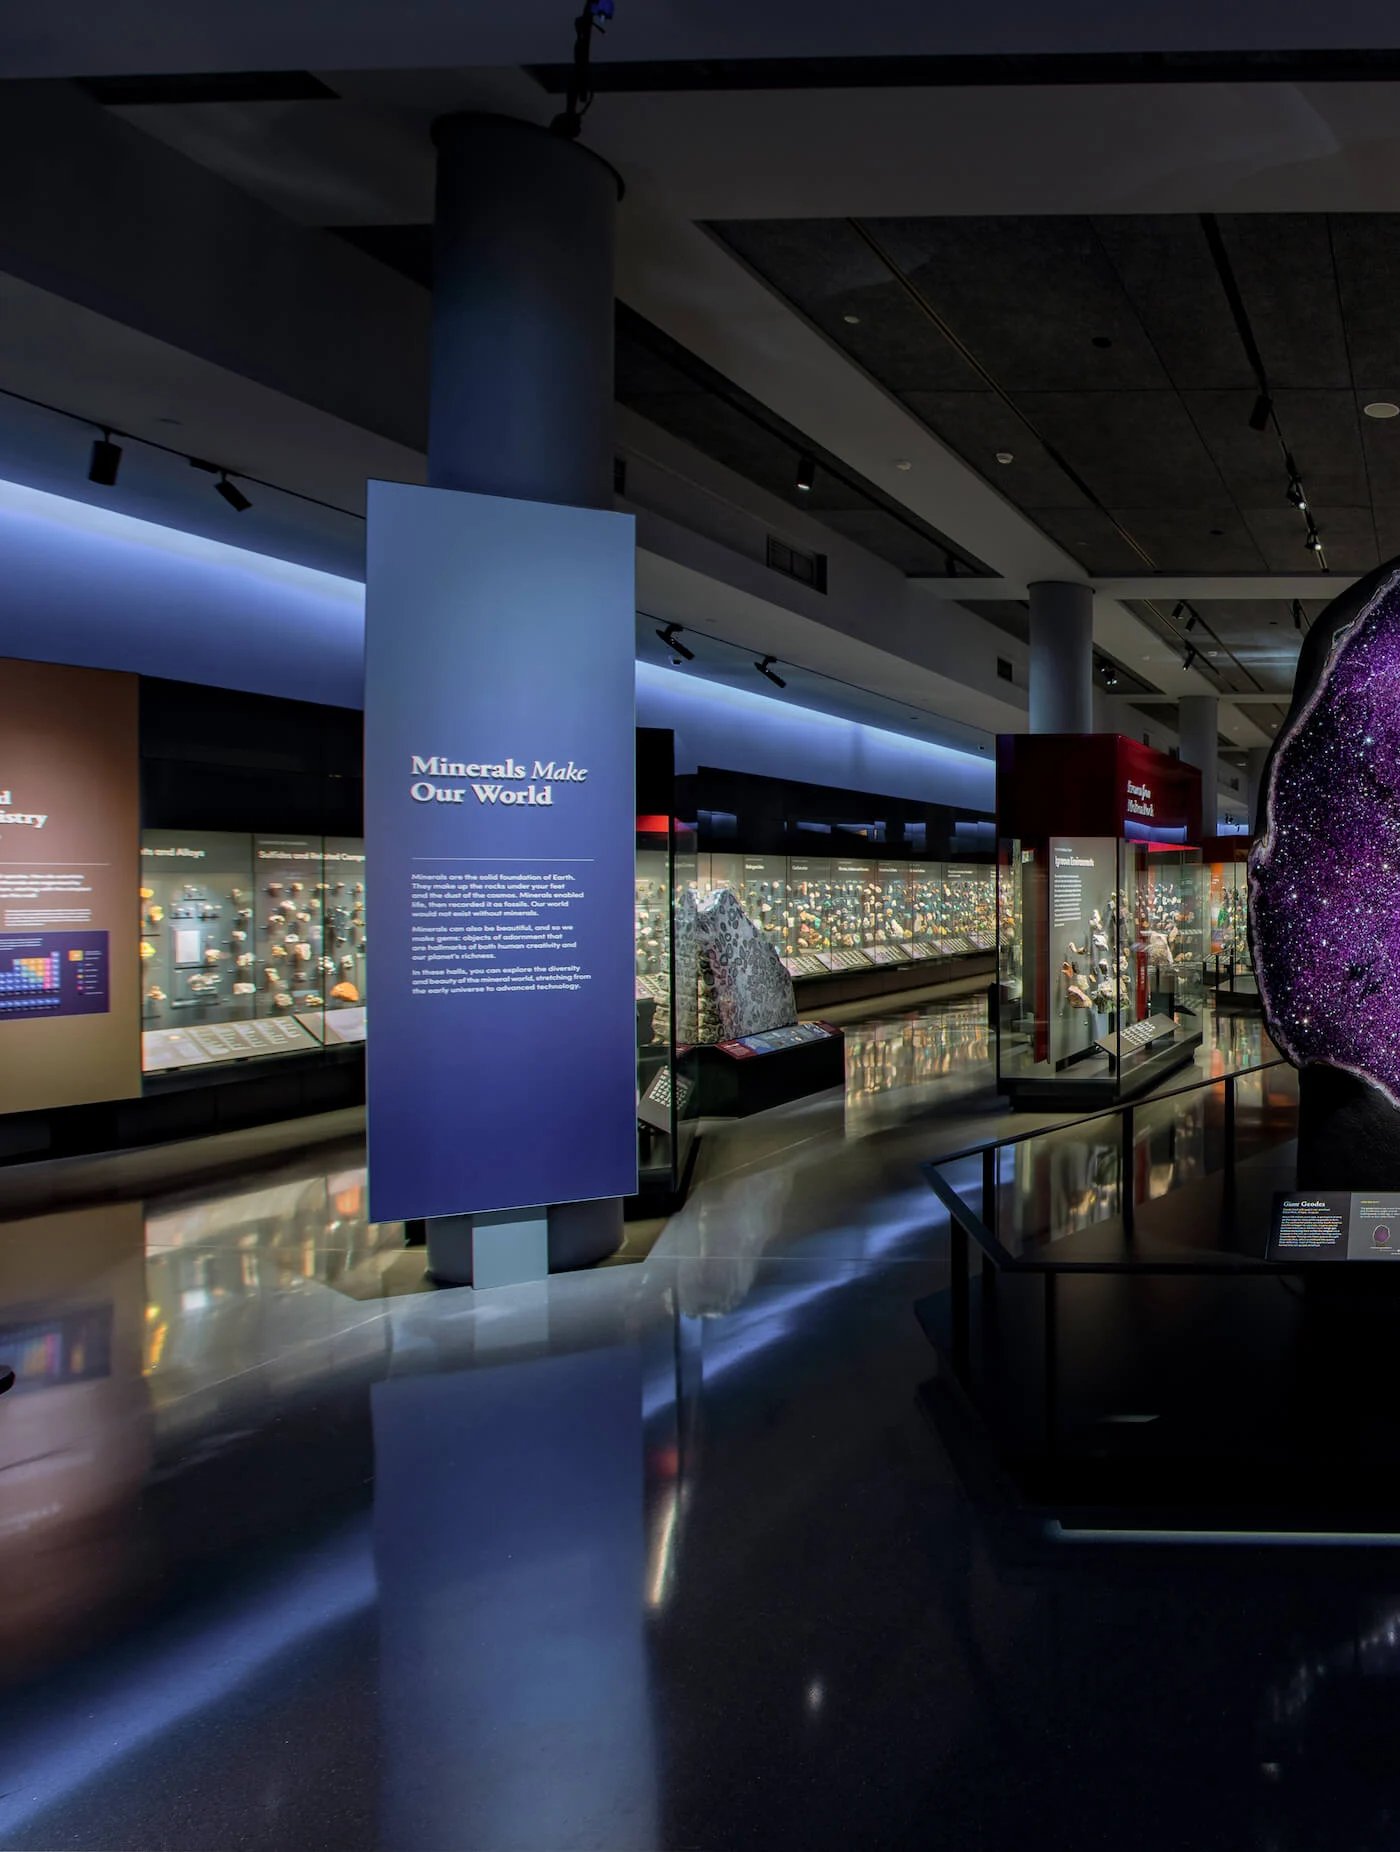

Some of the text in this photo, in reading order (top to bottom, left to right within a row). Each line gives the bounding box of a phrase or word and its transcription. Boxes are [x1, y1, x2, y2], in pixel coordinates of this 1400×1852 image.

[410, 755, 588, 782] Minerals Make
[410, 782, 553, 806] Our World
[0, 811, 48, 829] istry
[154, 848, 175, 856] and
[411, 883, 432, 892] They
[457, 884, 468, 892] up
